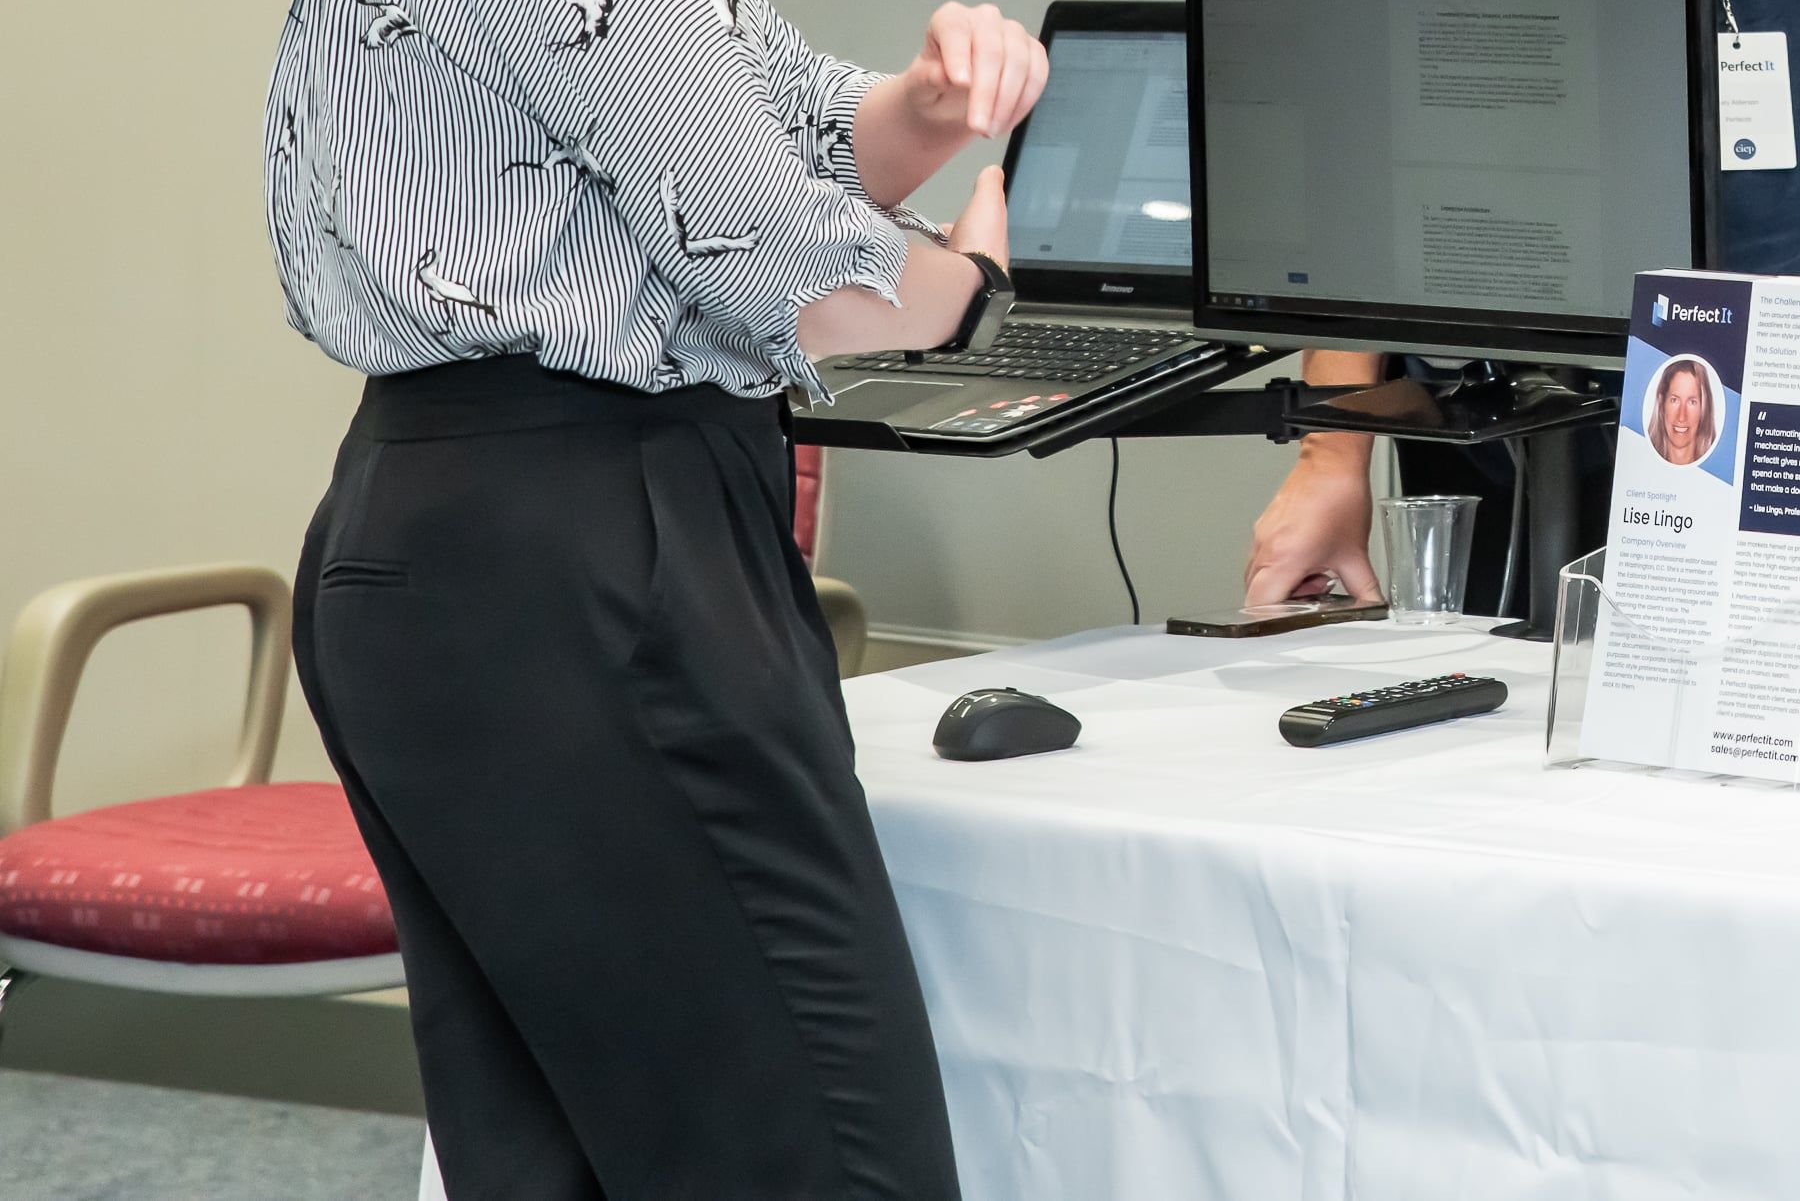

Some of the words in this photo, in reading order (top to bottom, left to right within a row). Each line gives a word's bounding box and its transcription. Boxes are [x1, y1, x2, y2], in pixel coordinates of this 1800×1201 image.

[1721, 61, 1775, 71] PerfectIt
[1672, 303, 1732, 323] PerfectIt
[1769, 347, 1797, 356] Solution
[1756, 427, 1764, 436] By
[1755, 441, 1793, 451] mechanical
[1781, 458, 1798, 467] gives
[1752, 470, 1772, 479] spend
[1783, 472, 1793, 480] the
[1751, 483, 1764, 491] that
[1765, 485, 1783, 494] make
[1626, 489, 1646, 498] Client
[1647, 491, 1677, 502] Spotlight
[1754, 504, 1765, 513] Lise
[1624, 507, 1649, 524] Lise
[1654, 510, 1693, 533] Lingo
[1622, 537, 1654, 548] Company
[1655, 539, 1687, 550] Overview
[1713, 731, 1793, 748] www.perfectit.com
[1711, 745, 1799, 762] sales@perfectit.com
